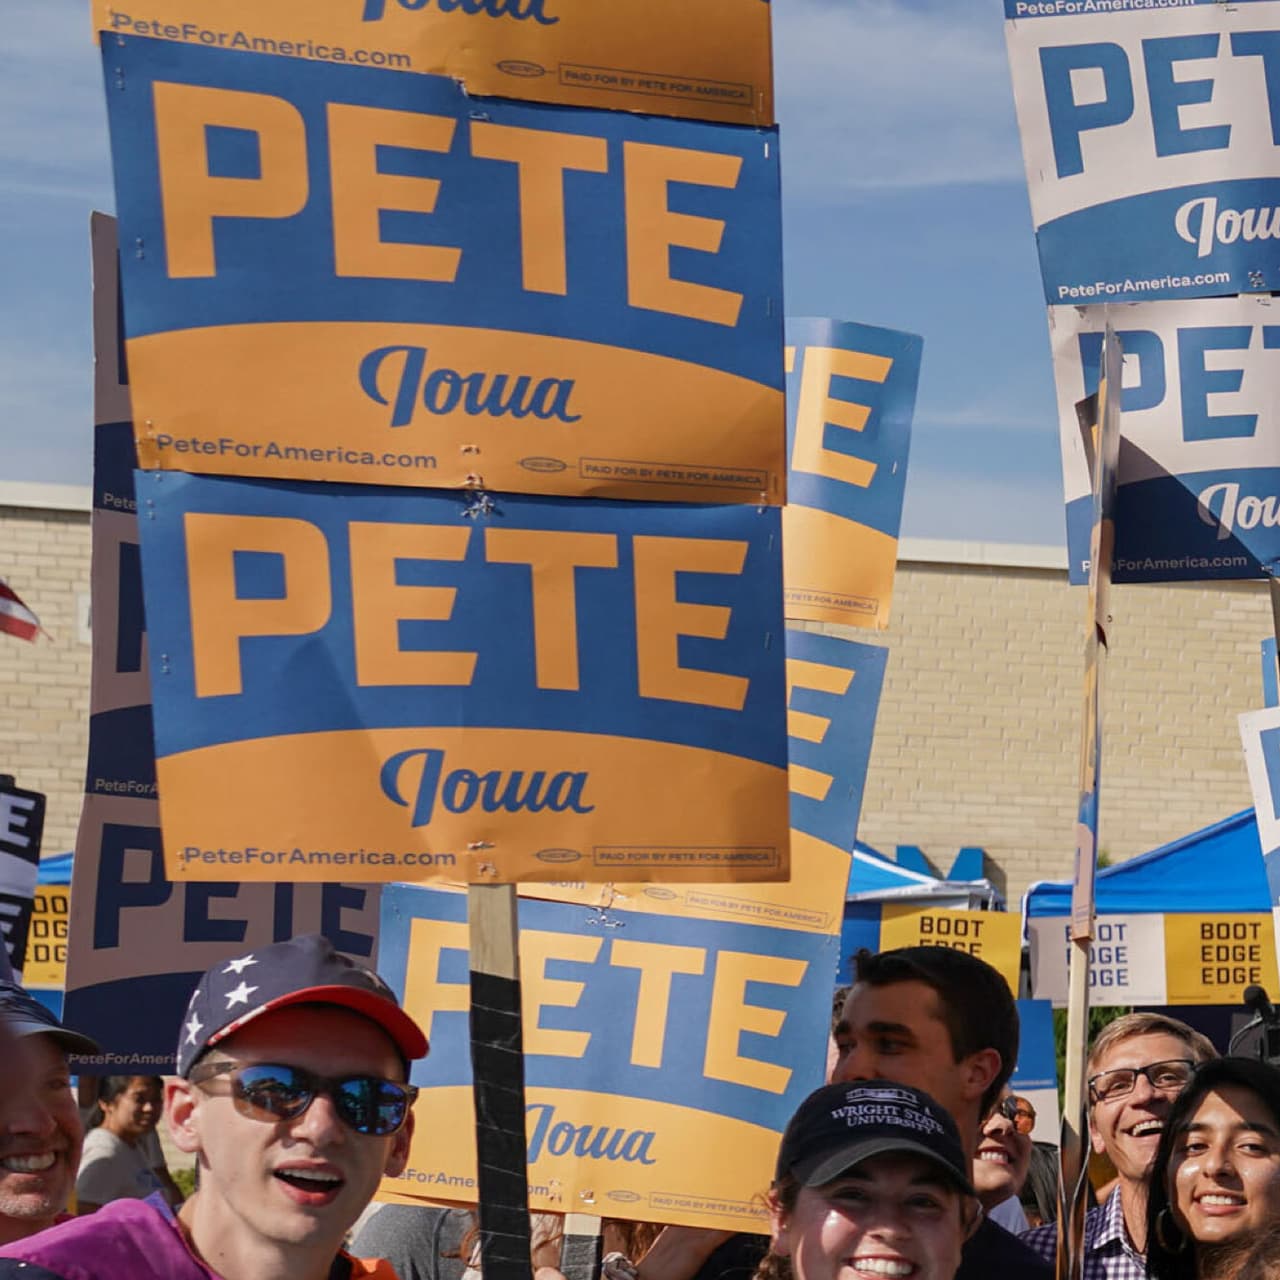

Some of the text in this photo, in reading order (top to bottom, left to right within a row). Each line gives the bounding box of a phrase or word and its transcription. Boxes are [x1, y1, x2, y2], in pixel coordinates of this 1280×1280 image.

[110, 11, 411, 68] PeteForAmerica.com
[152, 80, 744, 327] PETE
[1058, 270, 1230, 300] PeteForAmerica.com
[358, 344, 582, 428] Iowa
[155, 433, 438, 470] PeteForAmerica.com
[586, 463, 612, 474] PAID
[614, 465, 637, 475] FOR
[656, 469, 684, 479] PETE
[687, 471, 710, 480] FOR
[712, 473, 761, 485] AMERICA
[183, 511, 750, 710] PETE
[379, 747, 595, 827] Iowa
[184, 846, 457, 868] PeteForAmerica.com
[920, 916, 985, 938] BOOT
[1065, 923, 1128, 942] BOT
[1201, 922, 1262, 940] BOOT
[1202, 944, 1262, 963] EDGE
[1202, 966, 1262, 985] EDGE
[404, 917, 808, 1095] PETE
[526, 1103, 656, 1165] Iowa
[831, 1104, 945, 1135] WRIGHT STATE
[847, 1115, 936, 1135] UNIVERSITY
